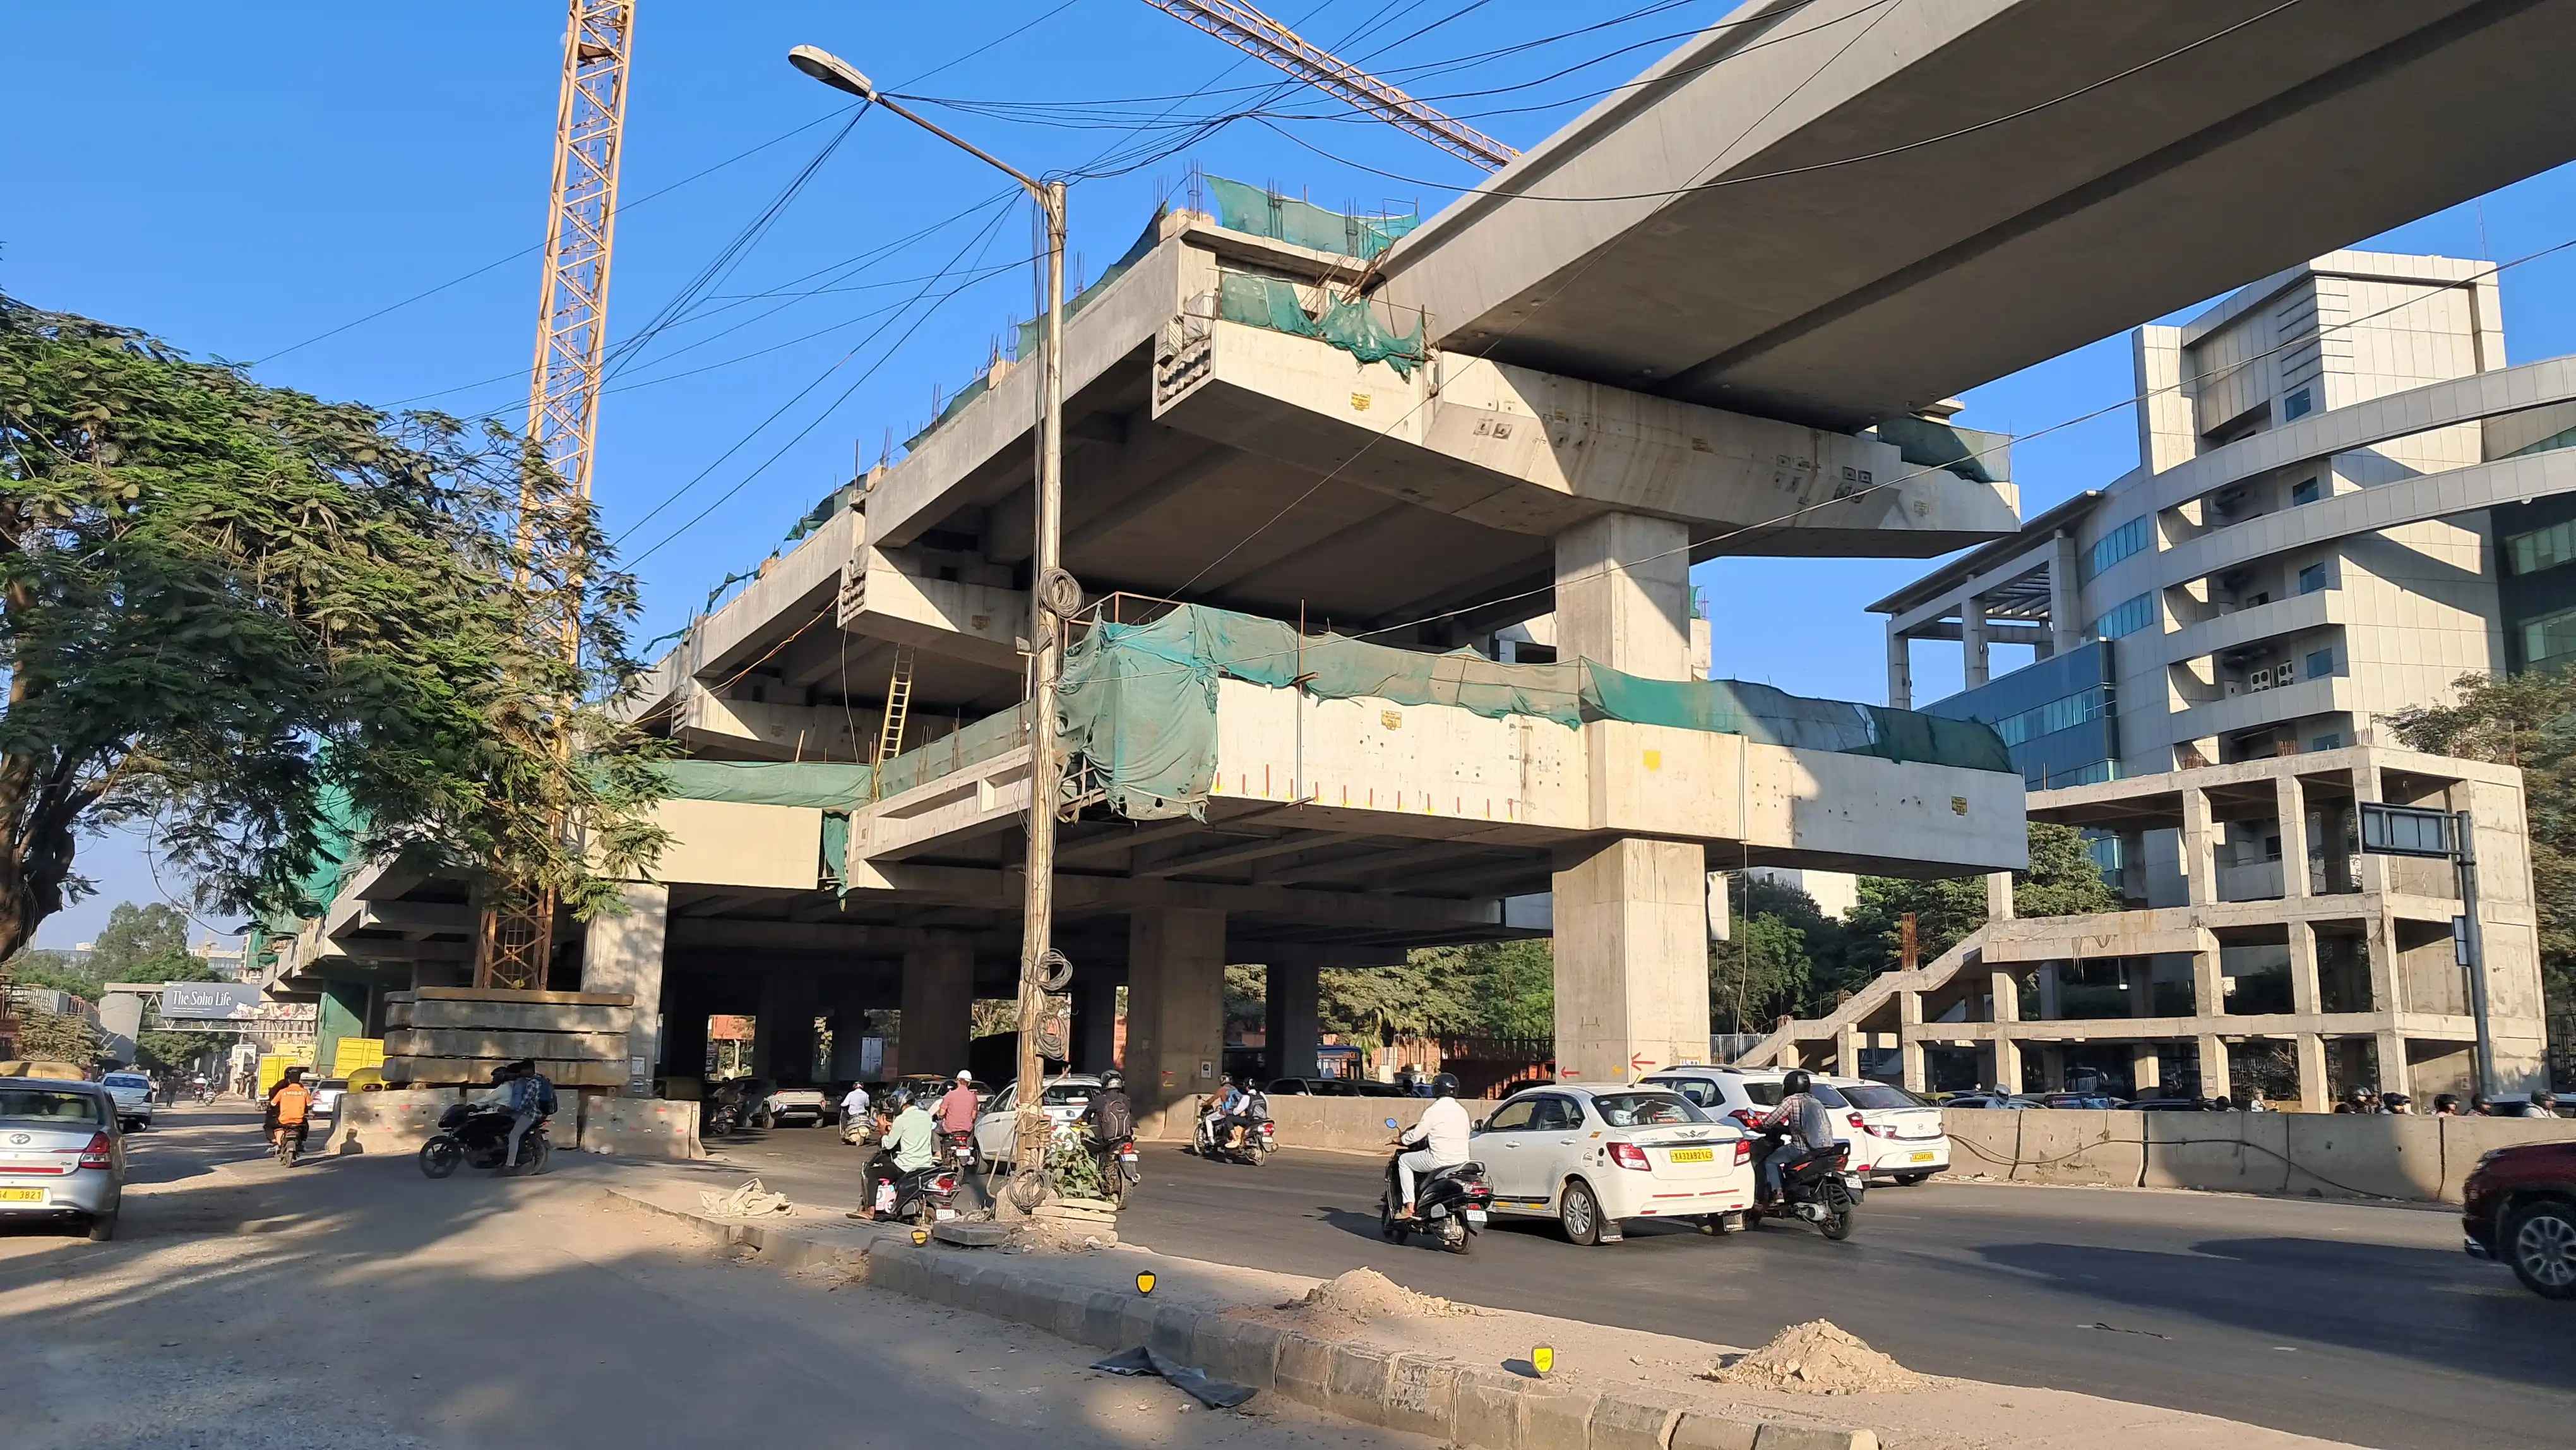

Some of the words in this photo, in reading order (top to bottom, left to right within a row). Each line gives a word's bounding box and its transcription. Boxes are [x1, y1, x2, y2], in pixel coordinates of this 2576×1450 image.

[173, 990, 189, 1005] The
[191, 991, 213, 1005] Soho
[215, 991, 232, 1006] Life
[20, 1190, 42, 1199] 3821
